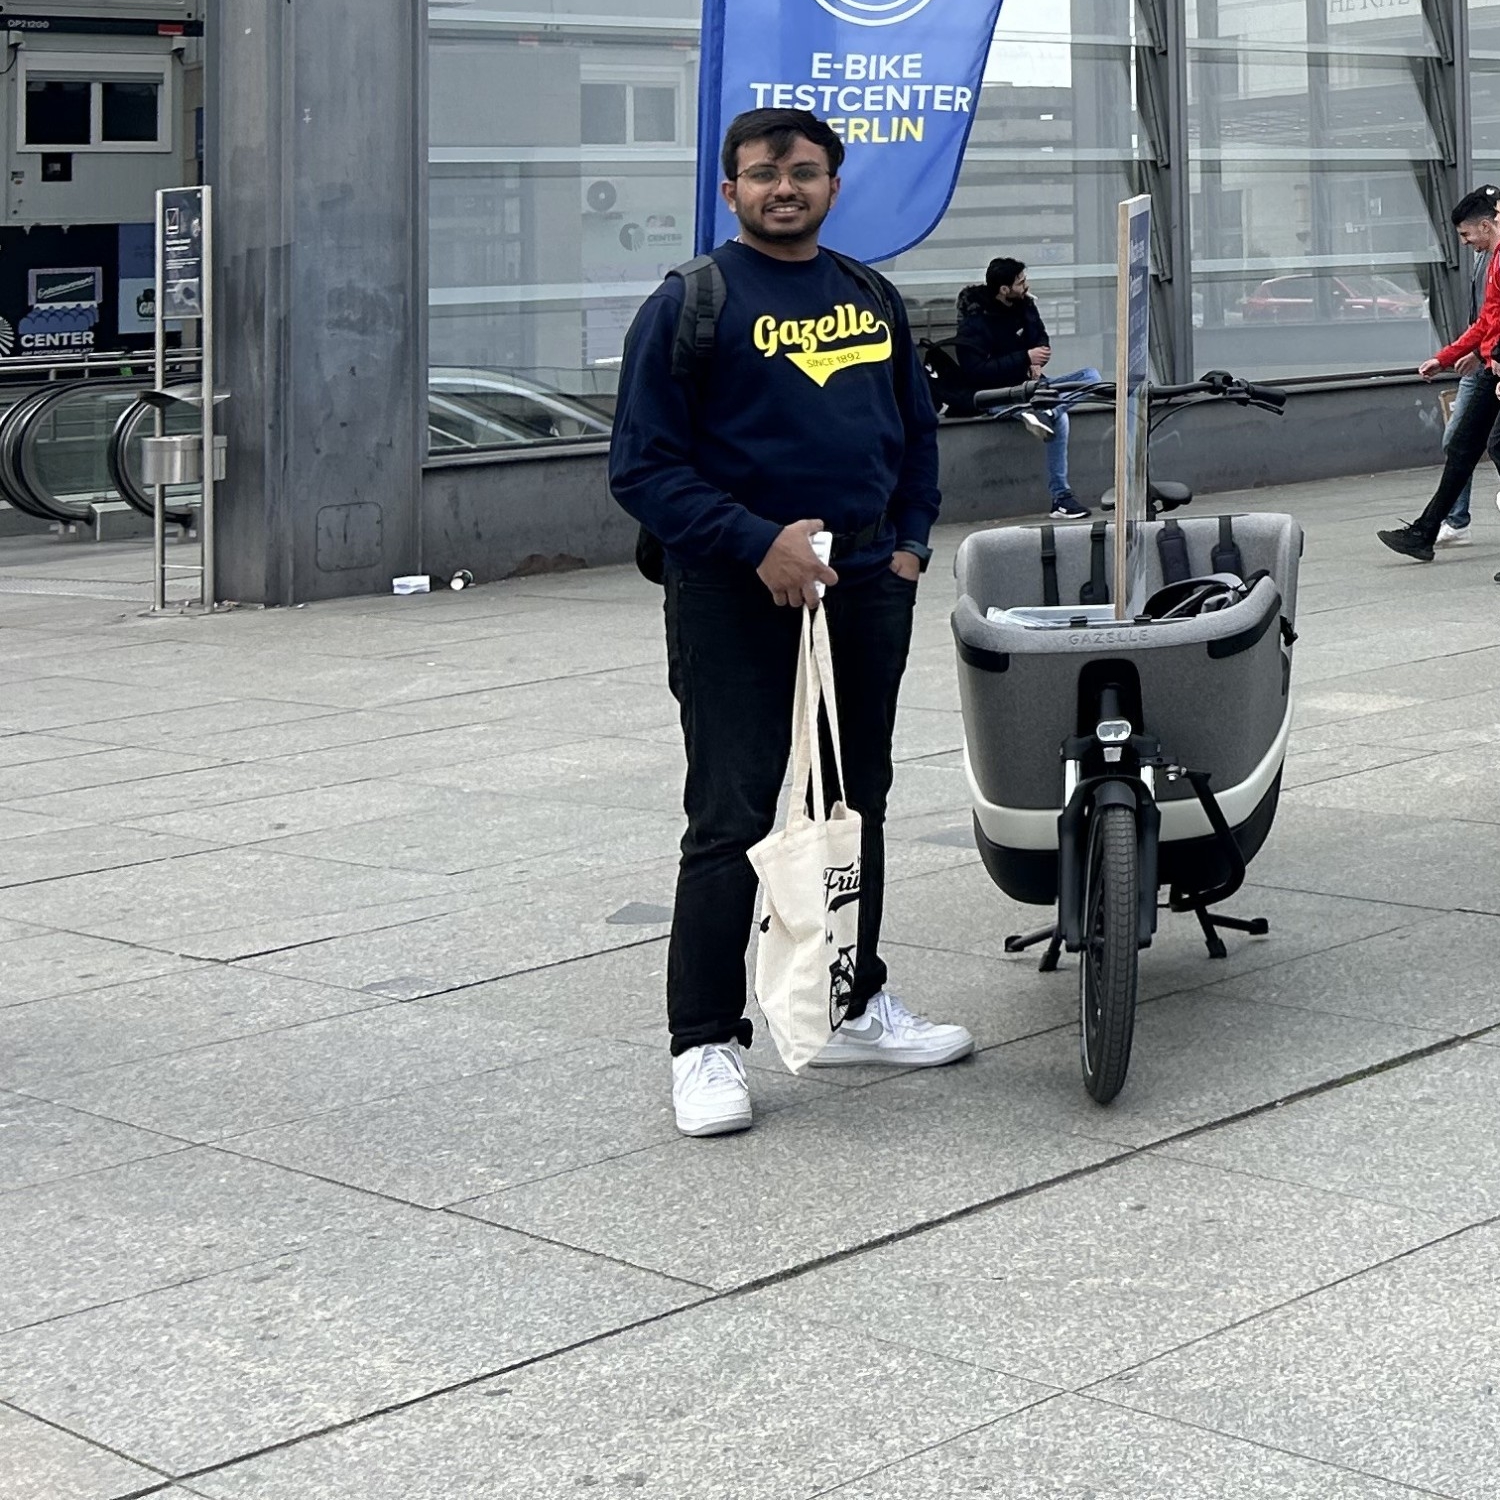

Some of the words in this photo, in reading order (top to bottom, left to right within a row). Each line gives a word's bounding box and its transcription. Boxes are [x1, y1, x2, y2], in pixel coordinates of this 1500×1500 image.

[811, 53, 923, 80] E-BIKE
[750, 83, 972, 113] TESTCENTER
[826, 116, 925, 143] ERLIN
[21, 331, 95, 348] CENTER
[753, 303, 878, 357] Gazelle
[806, 357, 834, 368] SINCE
[837, 351, 861, 367] 1892
[1068, 629, 1150, 646] GAZELLE
